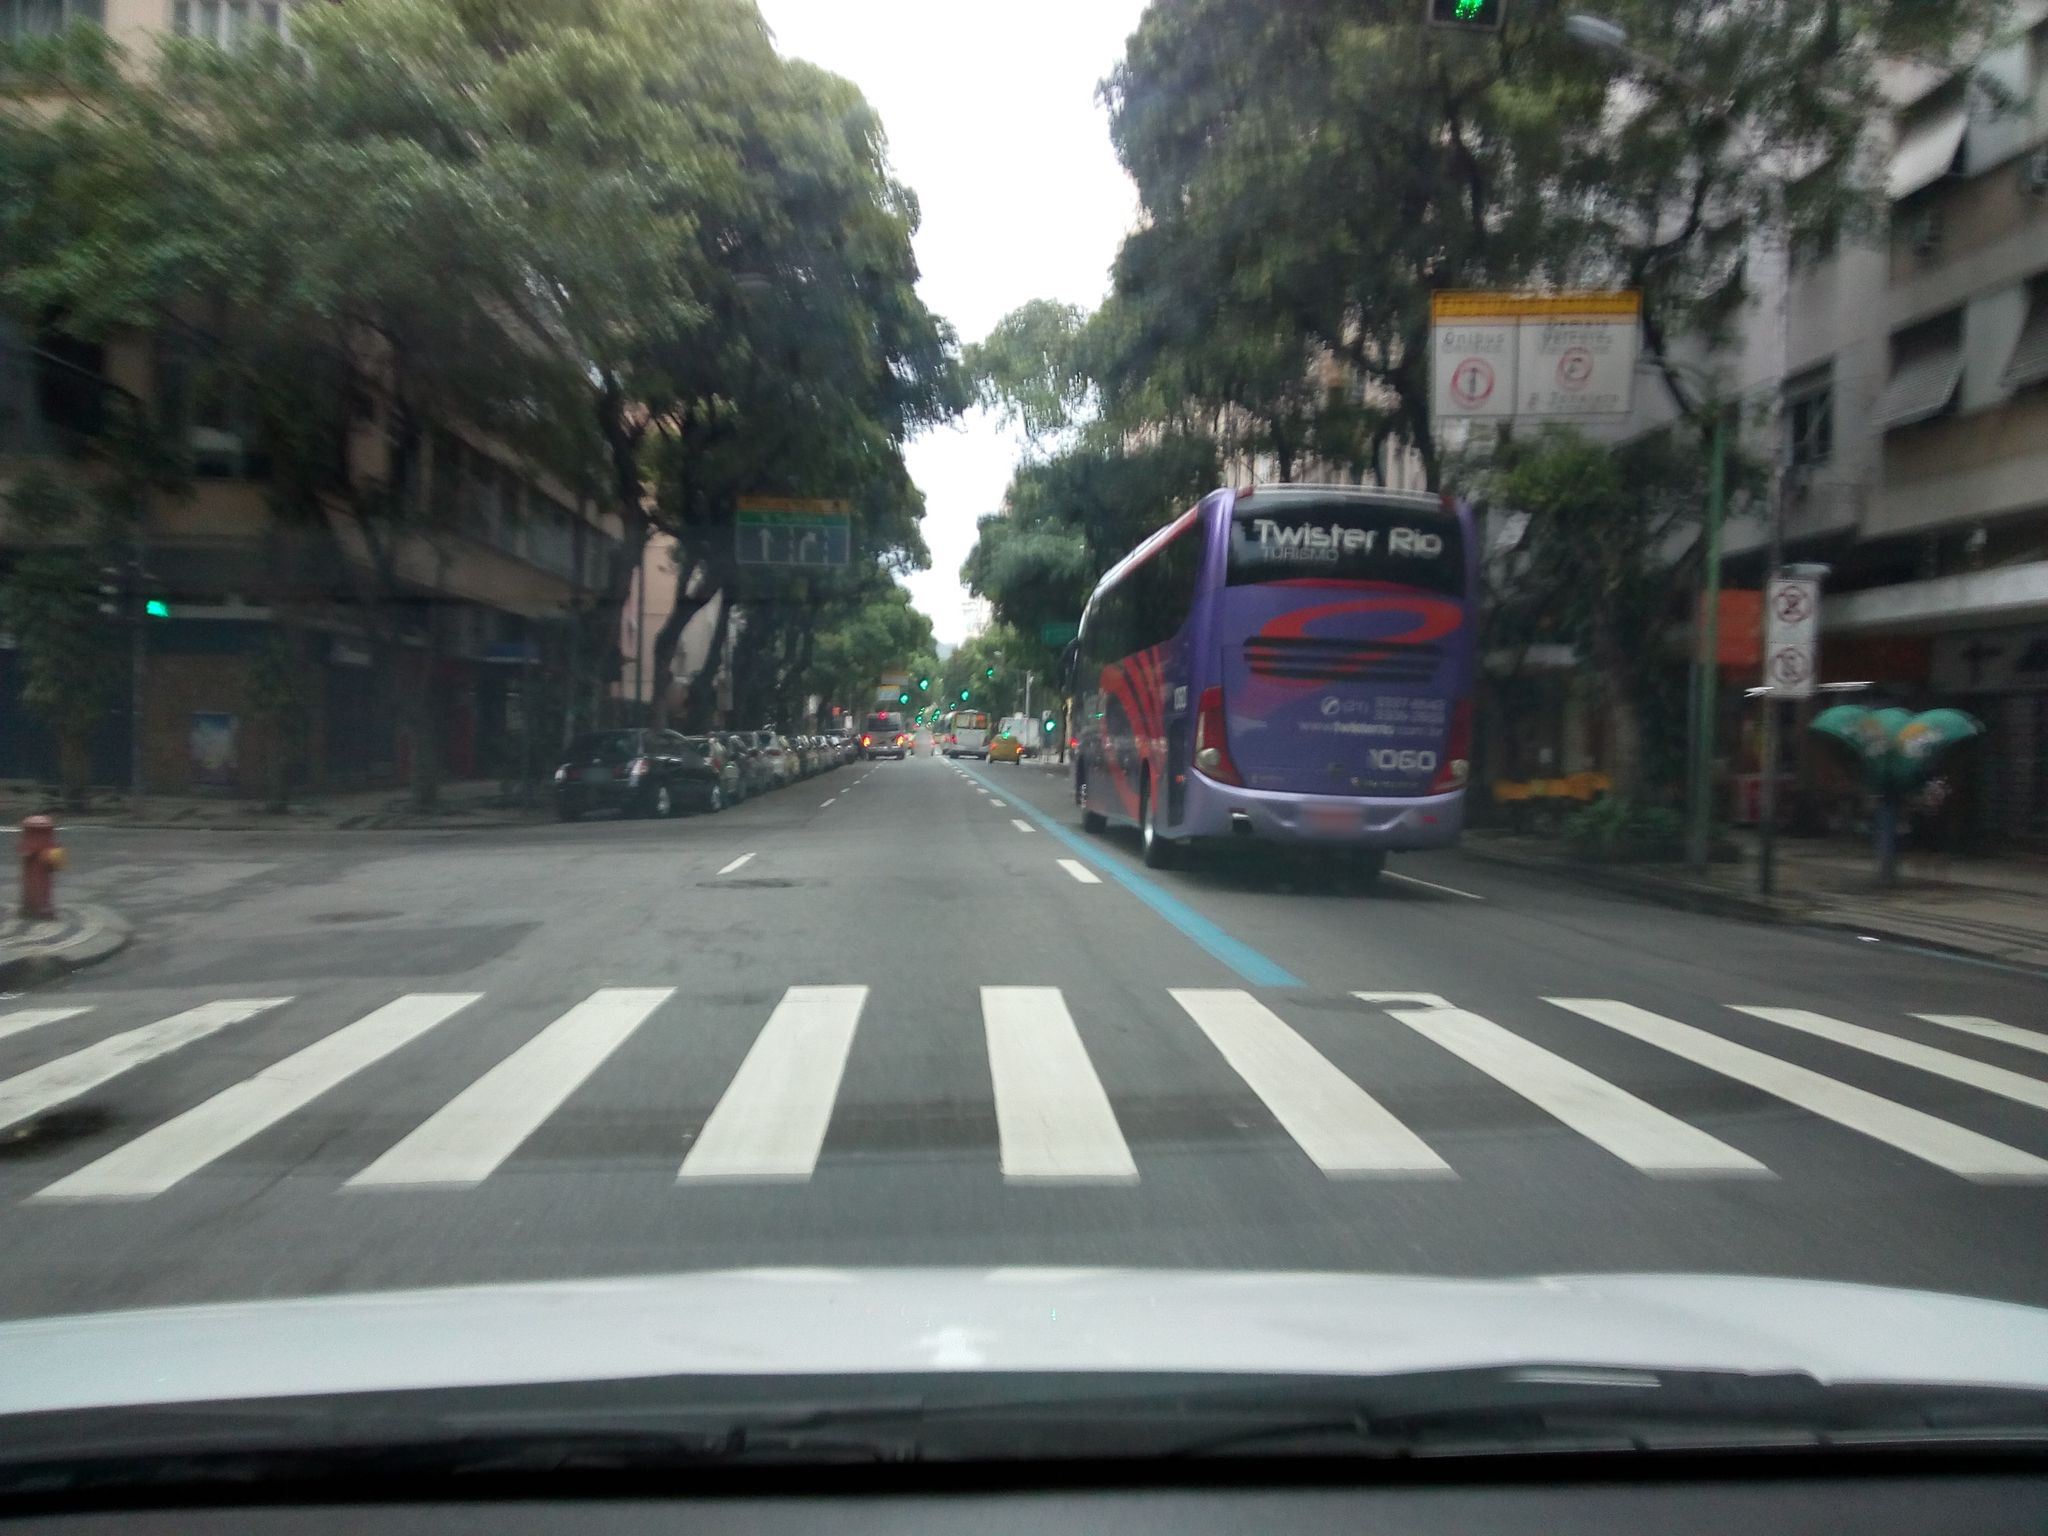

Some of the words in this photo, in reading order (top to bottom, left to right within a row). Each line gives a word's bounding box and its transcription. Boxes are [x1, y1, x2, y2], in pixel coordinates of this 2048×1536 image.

[1254, 519, 1378, 553] Twister
[1388, 526, 1443, 559] Rio
[1368, 749, 1437, 771] 1060
